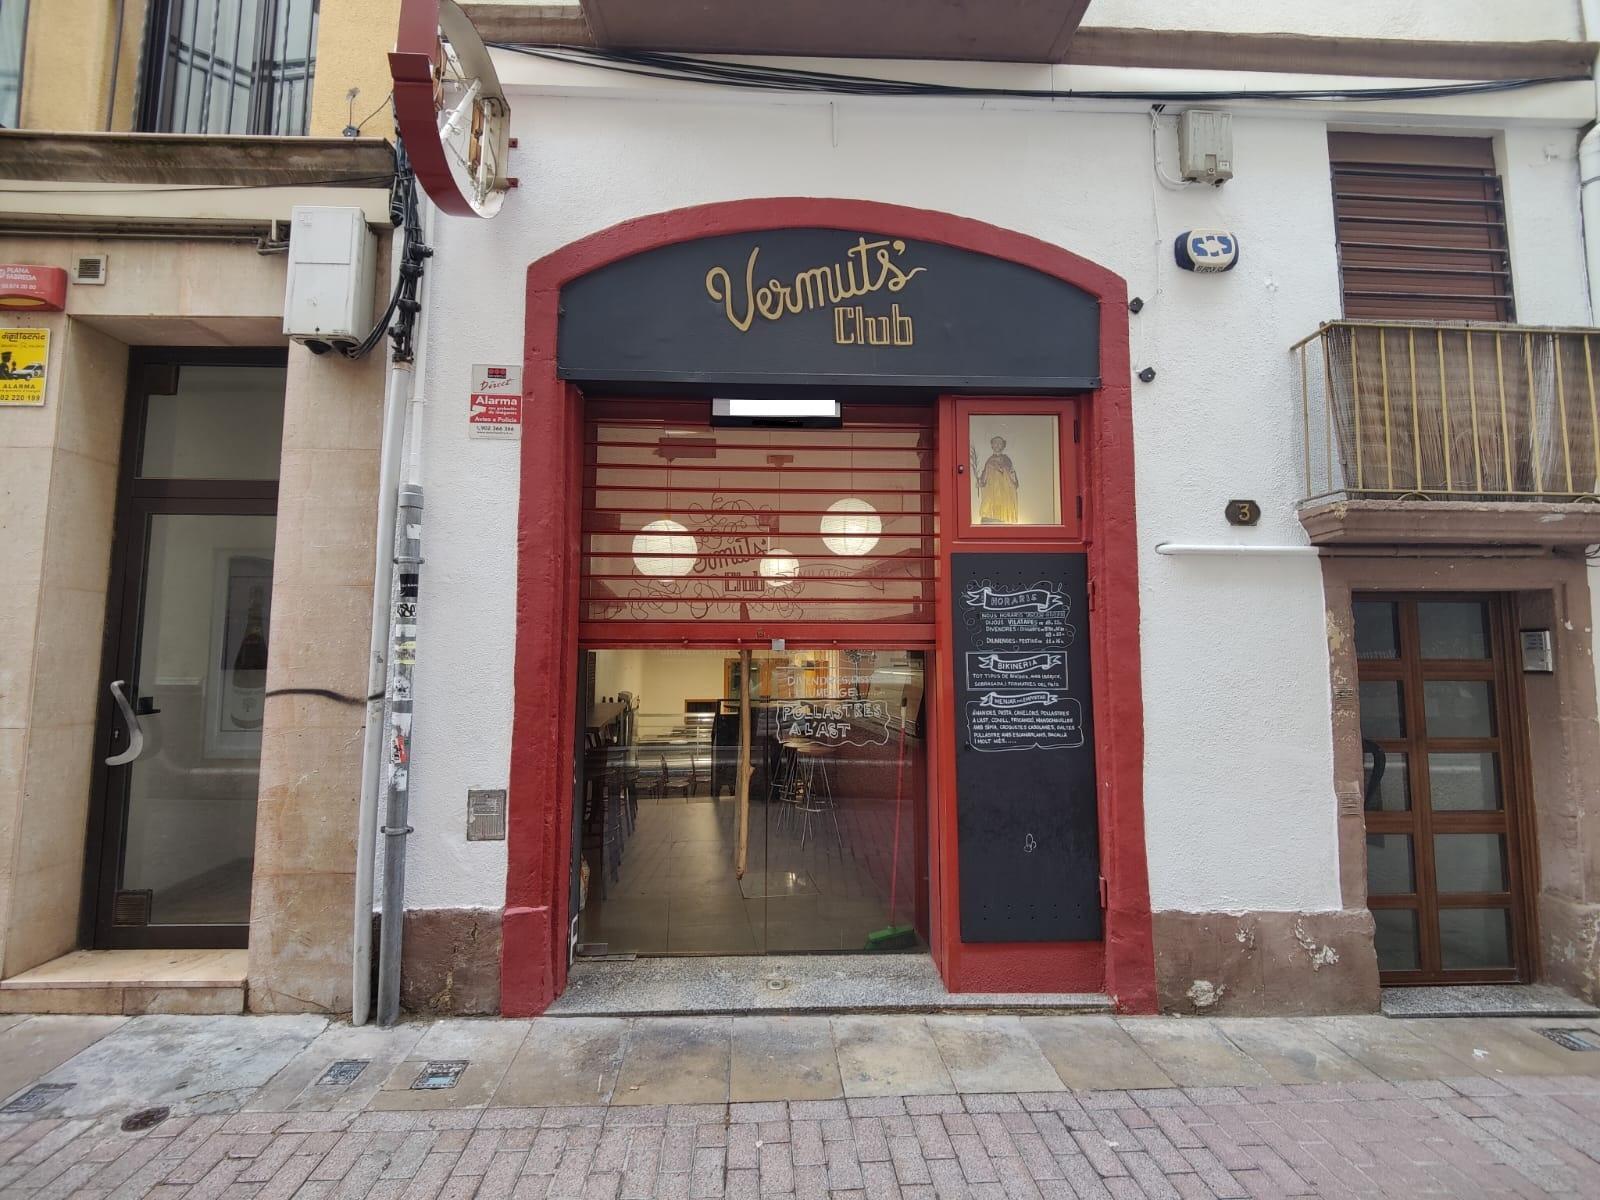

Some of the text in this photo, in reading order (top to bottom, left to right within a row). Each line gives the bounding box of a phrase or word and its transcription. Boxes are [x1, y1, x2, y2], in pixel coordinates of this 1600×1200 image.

[705, 237, 927, 332] Vermuts'
[834, 303, 913, 345] Club
[475, 396, 518, 406] Alarma
[1238, 503, 1250, 520] 3
[990, 593, 1038, 606] HORARIS
[997, 659, 1038, 670] BIKINERIA
[782, 703, 881, 721] POLLASTRES
[789, 722, 801, 736] A
